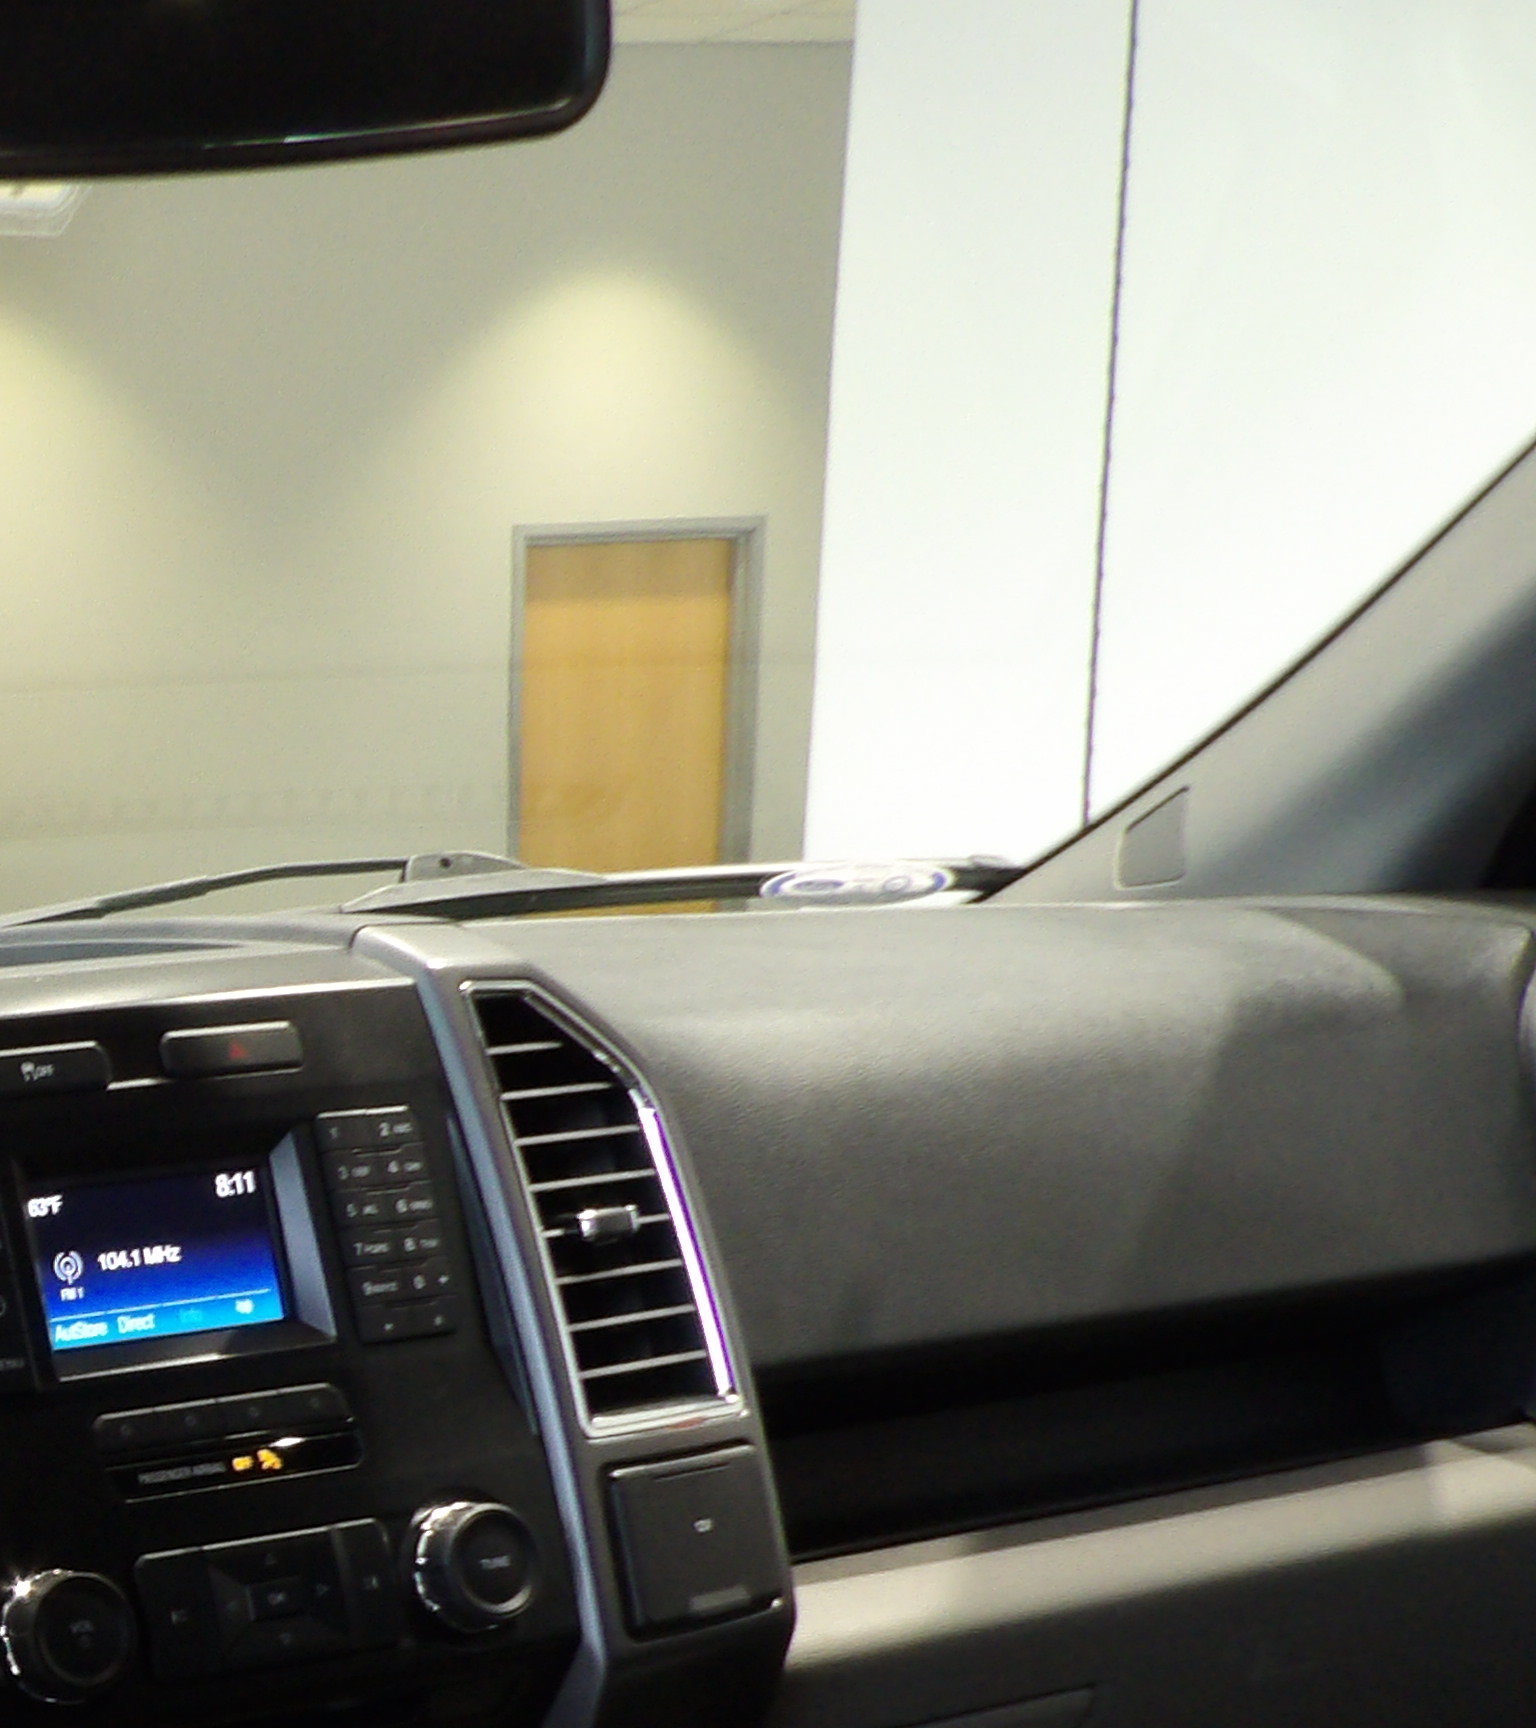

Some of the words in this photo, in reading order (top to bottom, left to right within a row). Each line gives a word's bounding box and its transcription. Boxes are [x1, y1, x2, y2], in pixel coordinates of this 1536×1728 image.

[379, 1122, 391, 1137] 2
[337, 1165, 349, 1180] 3
[387, 1160, 399, 1173] 4
[215, 1171, 256, 1198] 8:11
[395, 1198, 408, 1214] 6
[353, 1242, 364, 1257] 7
[97, 1252, 141, 1272] 104.1
[143, 1245, 182, 1266] MHz
[117, 1313, 156, 1334] Direct
